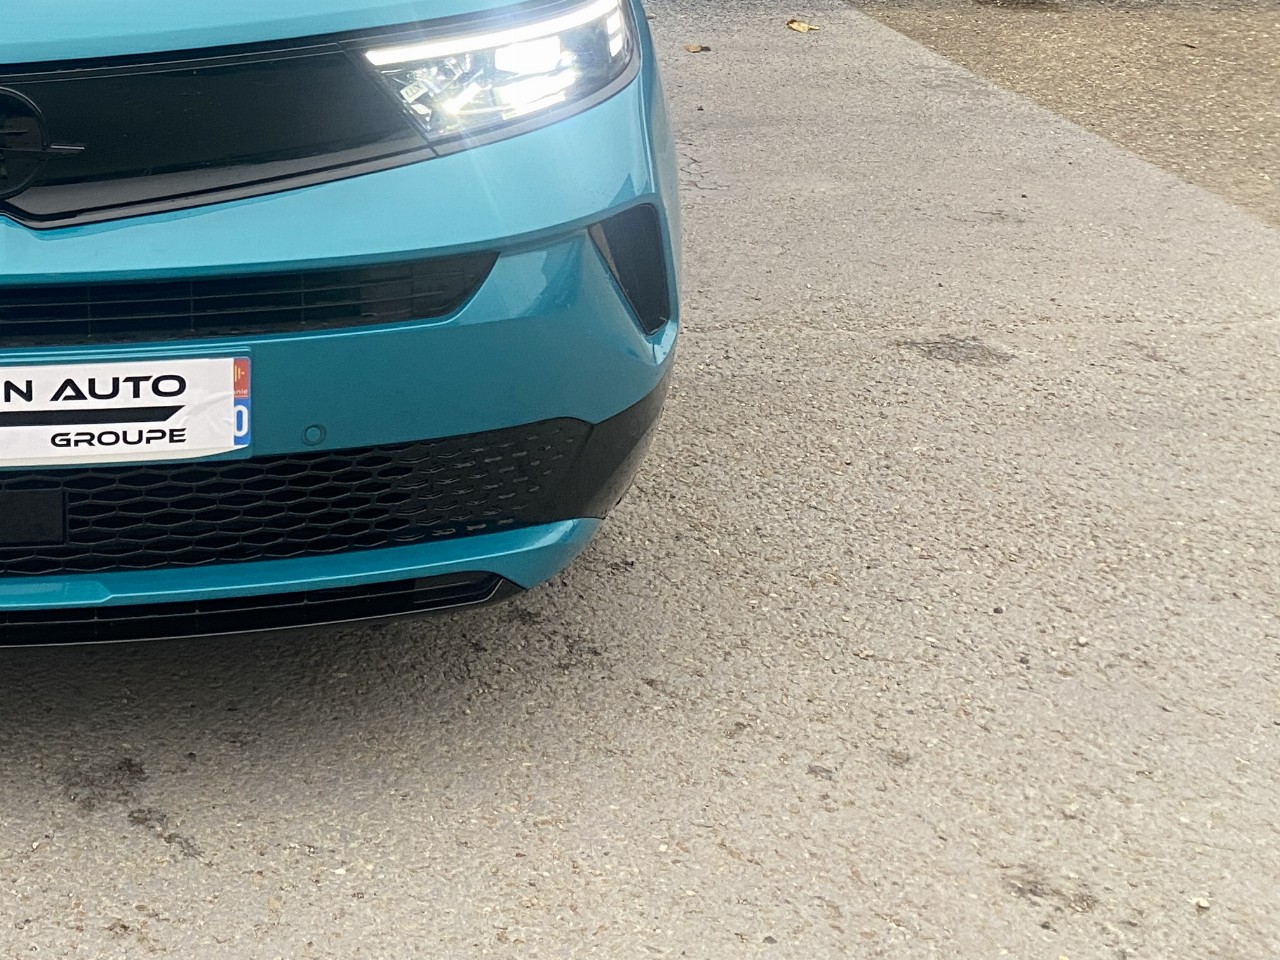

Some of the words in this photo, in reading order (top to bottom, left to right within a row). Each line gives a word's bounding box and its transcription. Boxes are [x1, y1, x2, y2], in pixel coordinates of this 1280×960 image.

[50, 374, 187, 402] AUTO
[233, 404, 249, 437] 0
[50, 427, 187, 448] GROUPE
